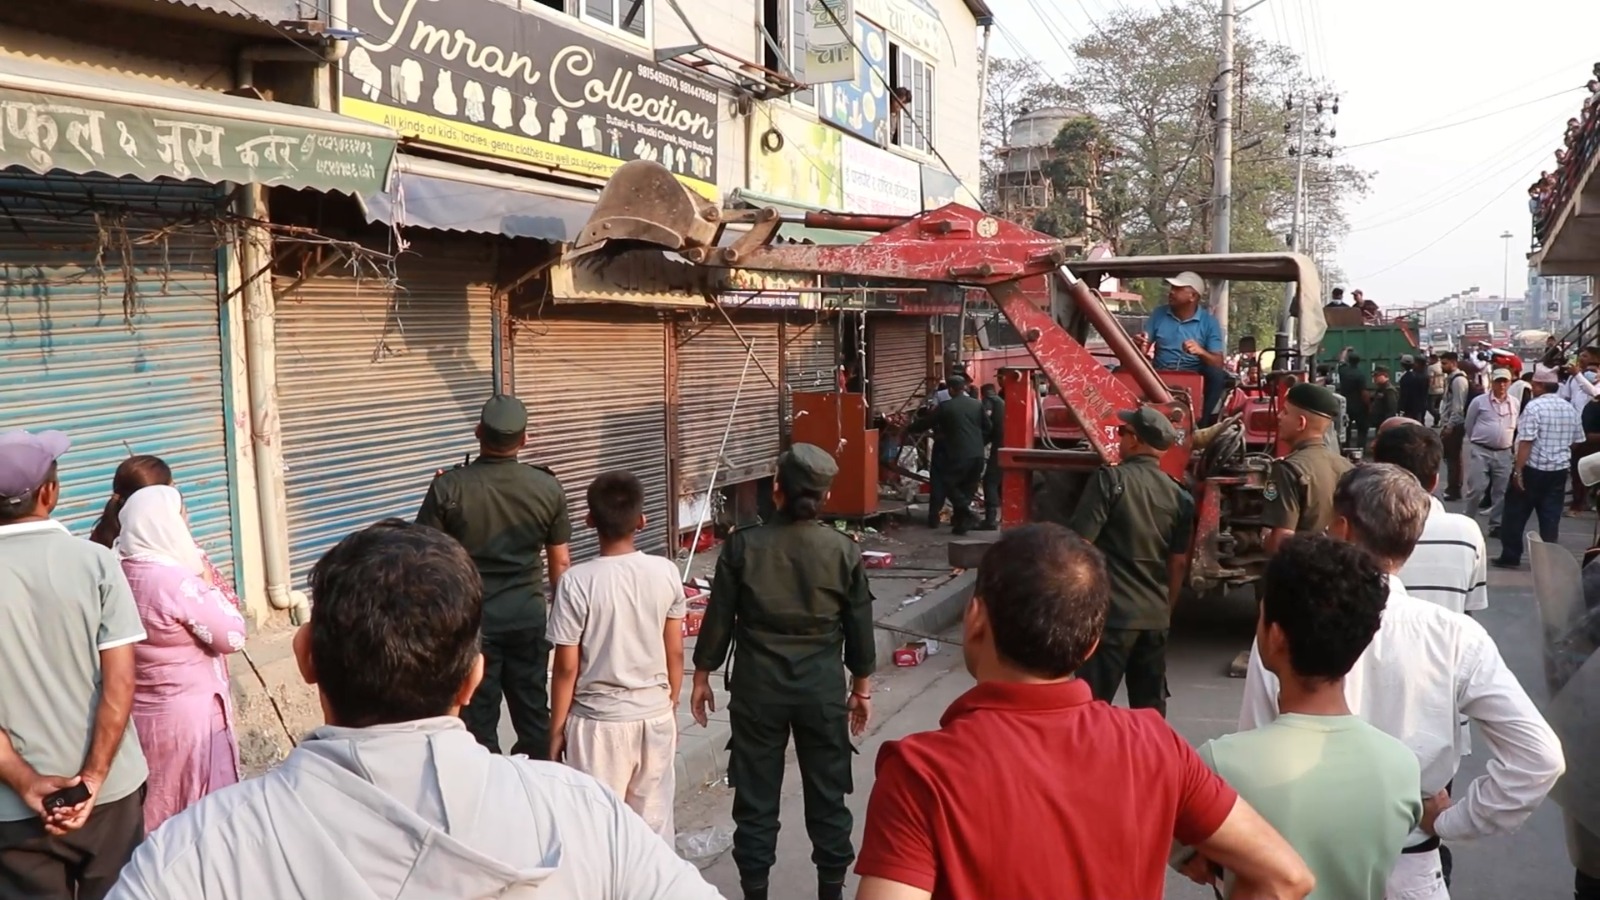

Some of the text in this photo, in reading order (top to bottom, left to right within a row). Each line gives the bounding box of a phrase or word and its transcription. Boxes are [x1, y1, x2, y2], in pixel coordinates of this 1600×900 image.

[549, 45, 714, 140] Collection
[384, 114, 397, 126] All
[398, 117, 425, 133] kinds
[427, 125, 438, 135] of
[491, 139, 514, 153] gents
[515, 144, 544, 159] clothes
[545, 152, 554, 161] as
[555, 154, 570, 165] well
[571, 158, 580, 166] as
